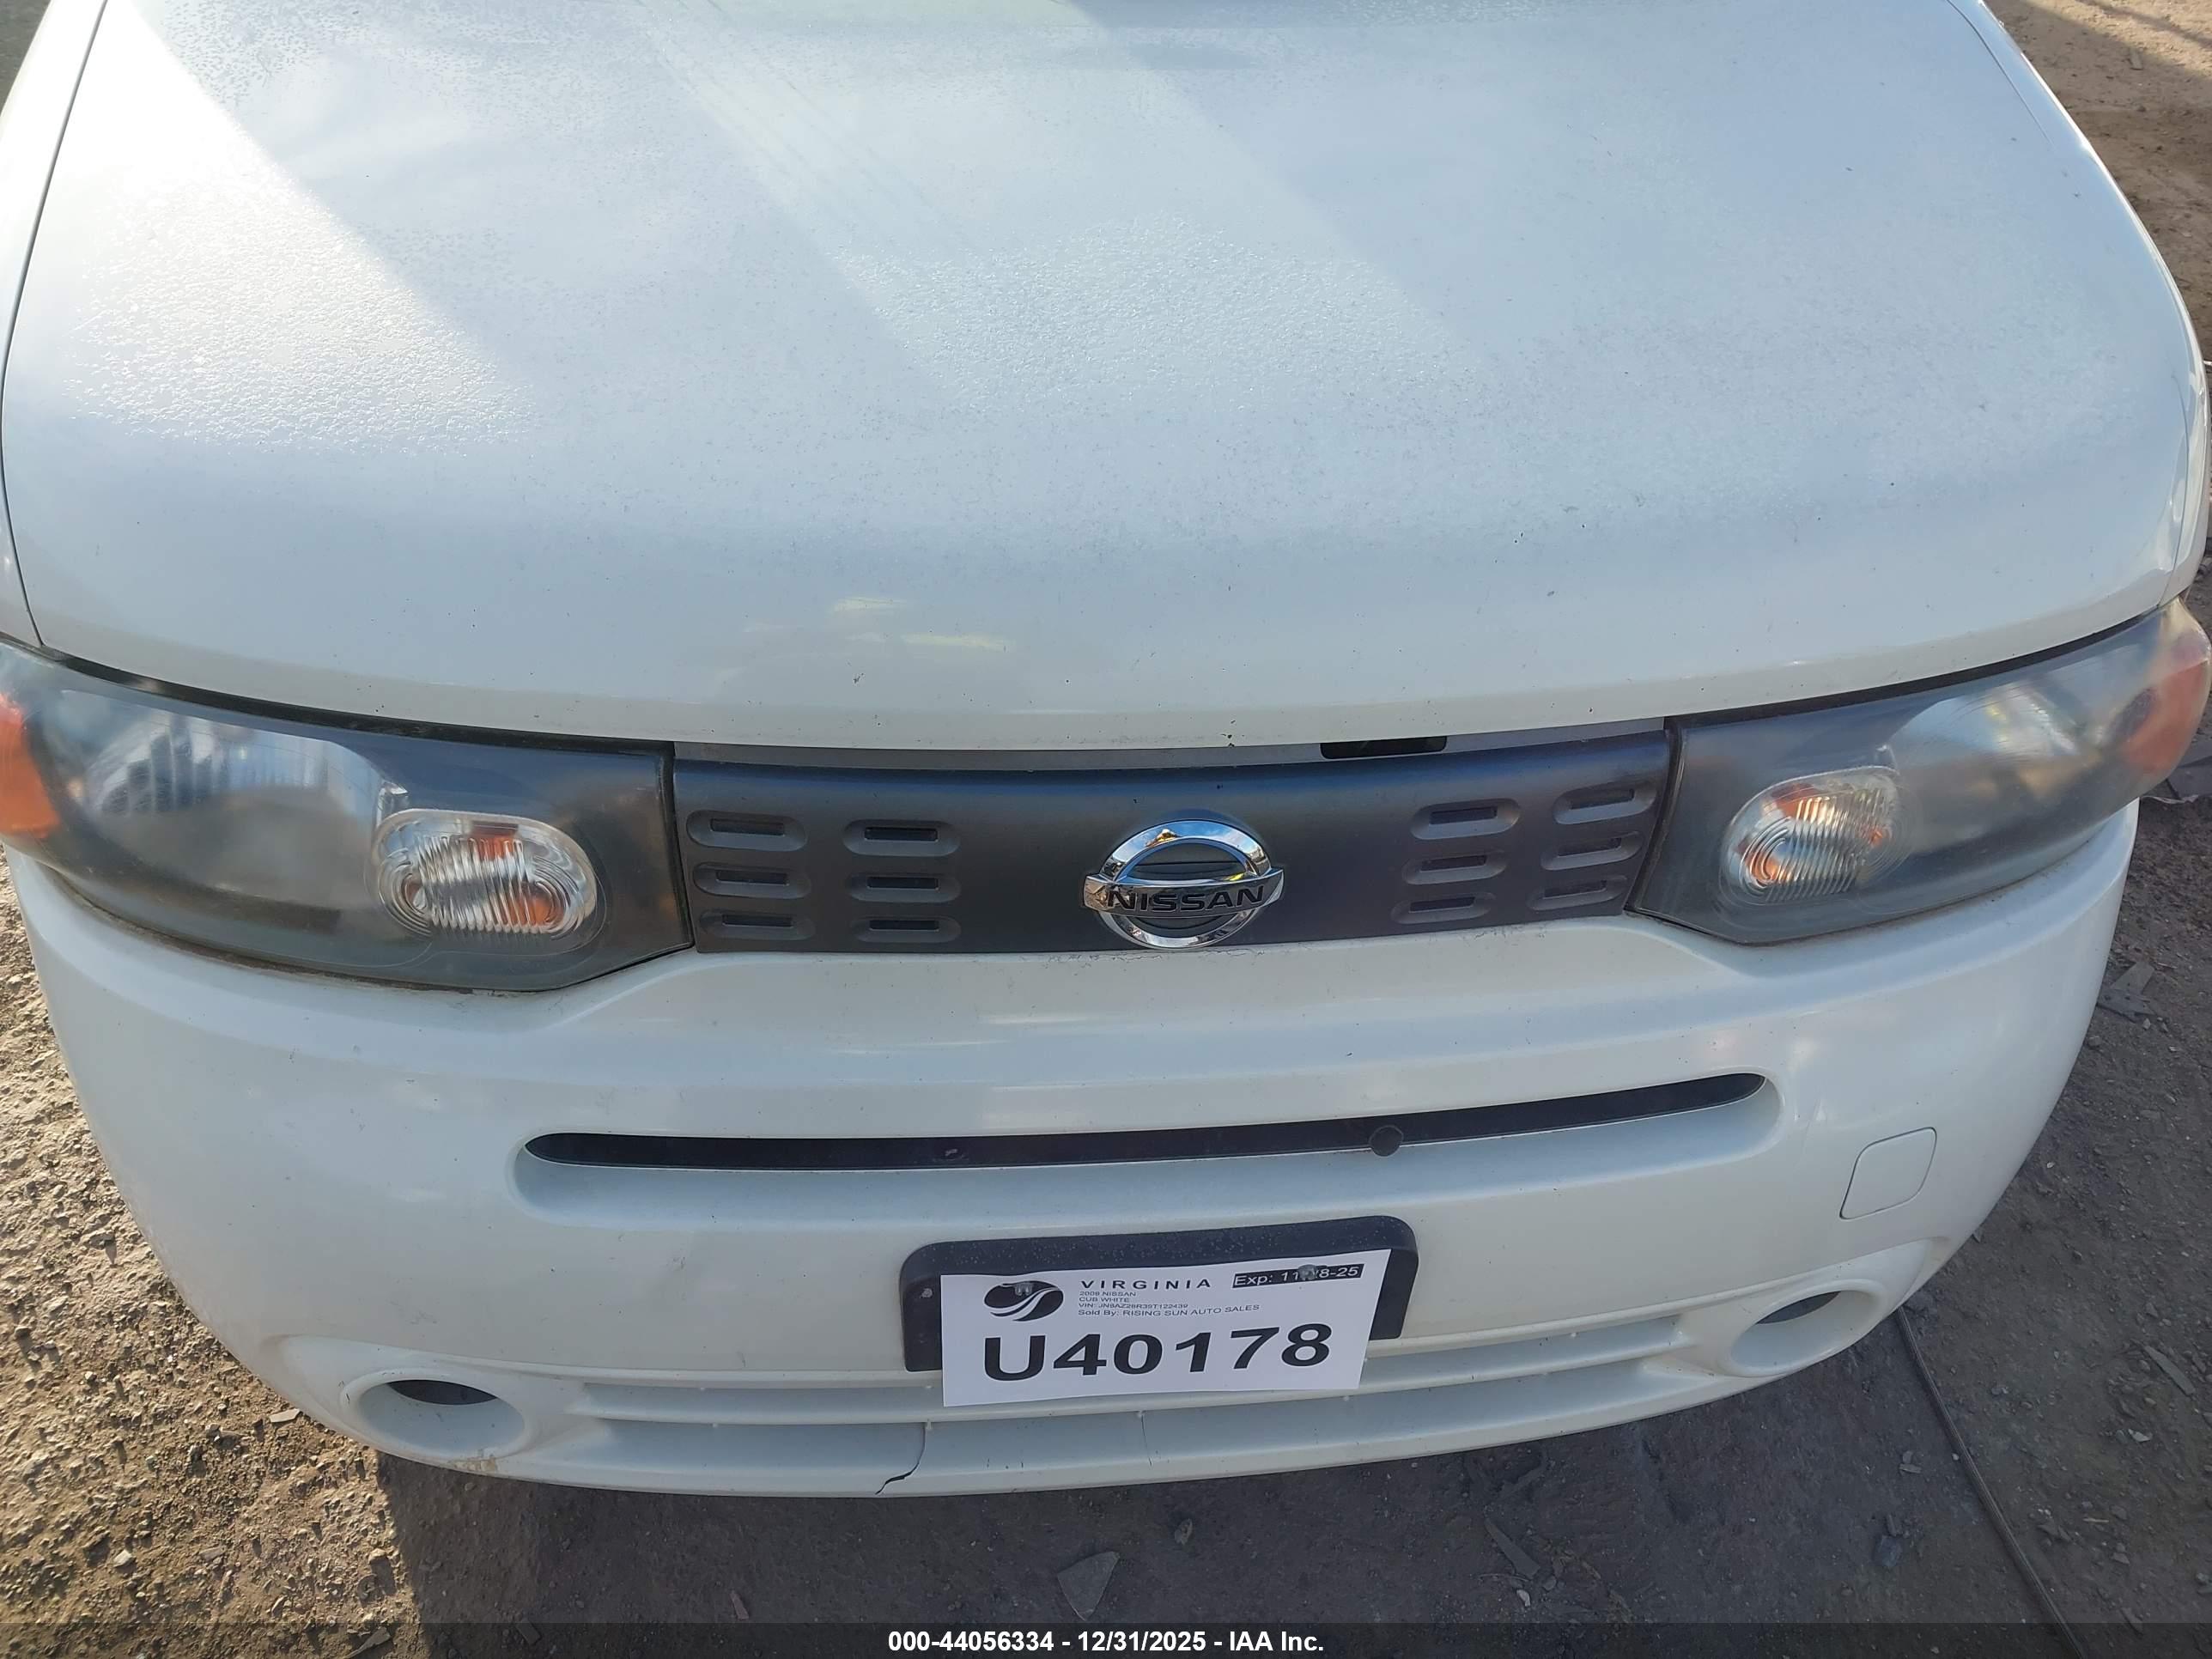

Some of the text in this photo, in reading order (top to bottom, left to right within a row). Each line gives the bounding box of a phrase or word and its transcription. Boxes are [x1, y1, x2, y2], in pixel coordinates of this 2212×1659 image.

[1107, 885, 1264, 912] NISSAN
[1081, 1279, 1211, 1290] VIRGINIA
[1234, 1274, 1273, 1287] Exp:
[984, 1323, 1333, 1381] U40178
